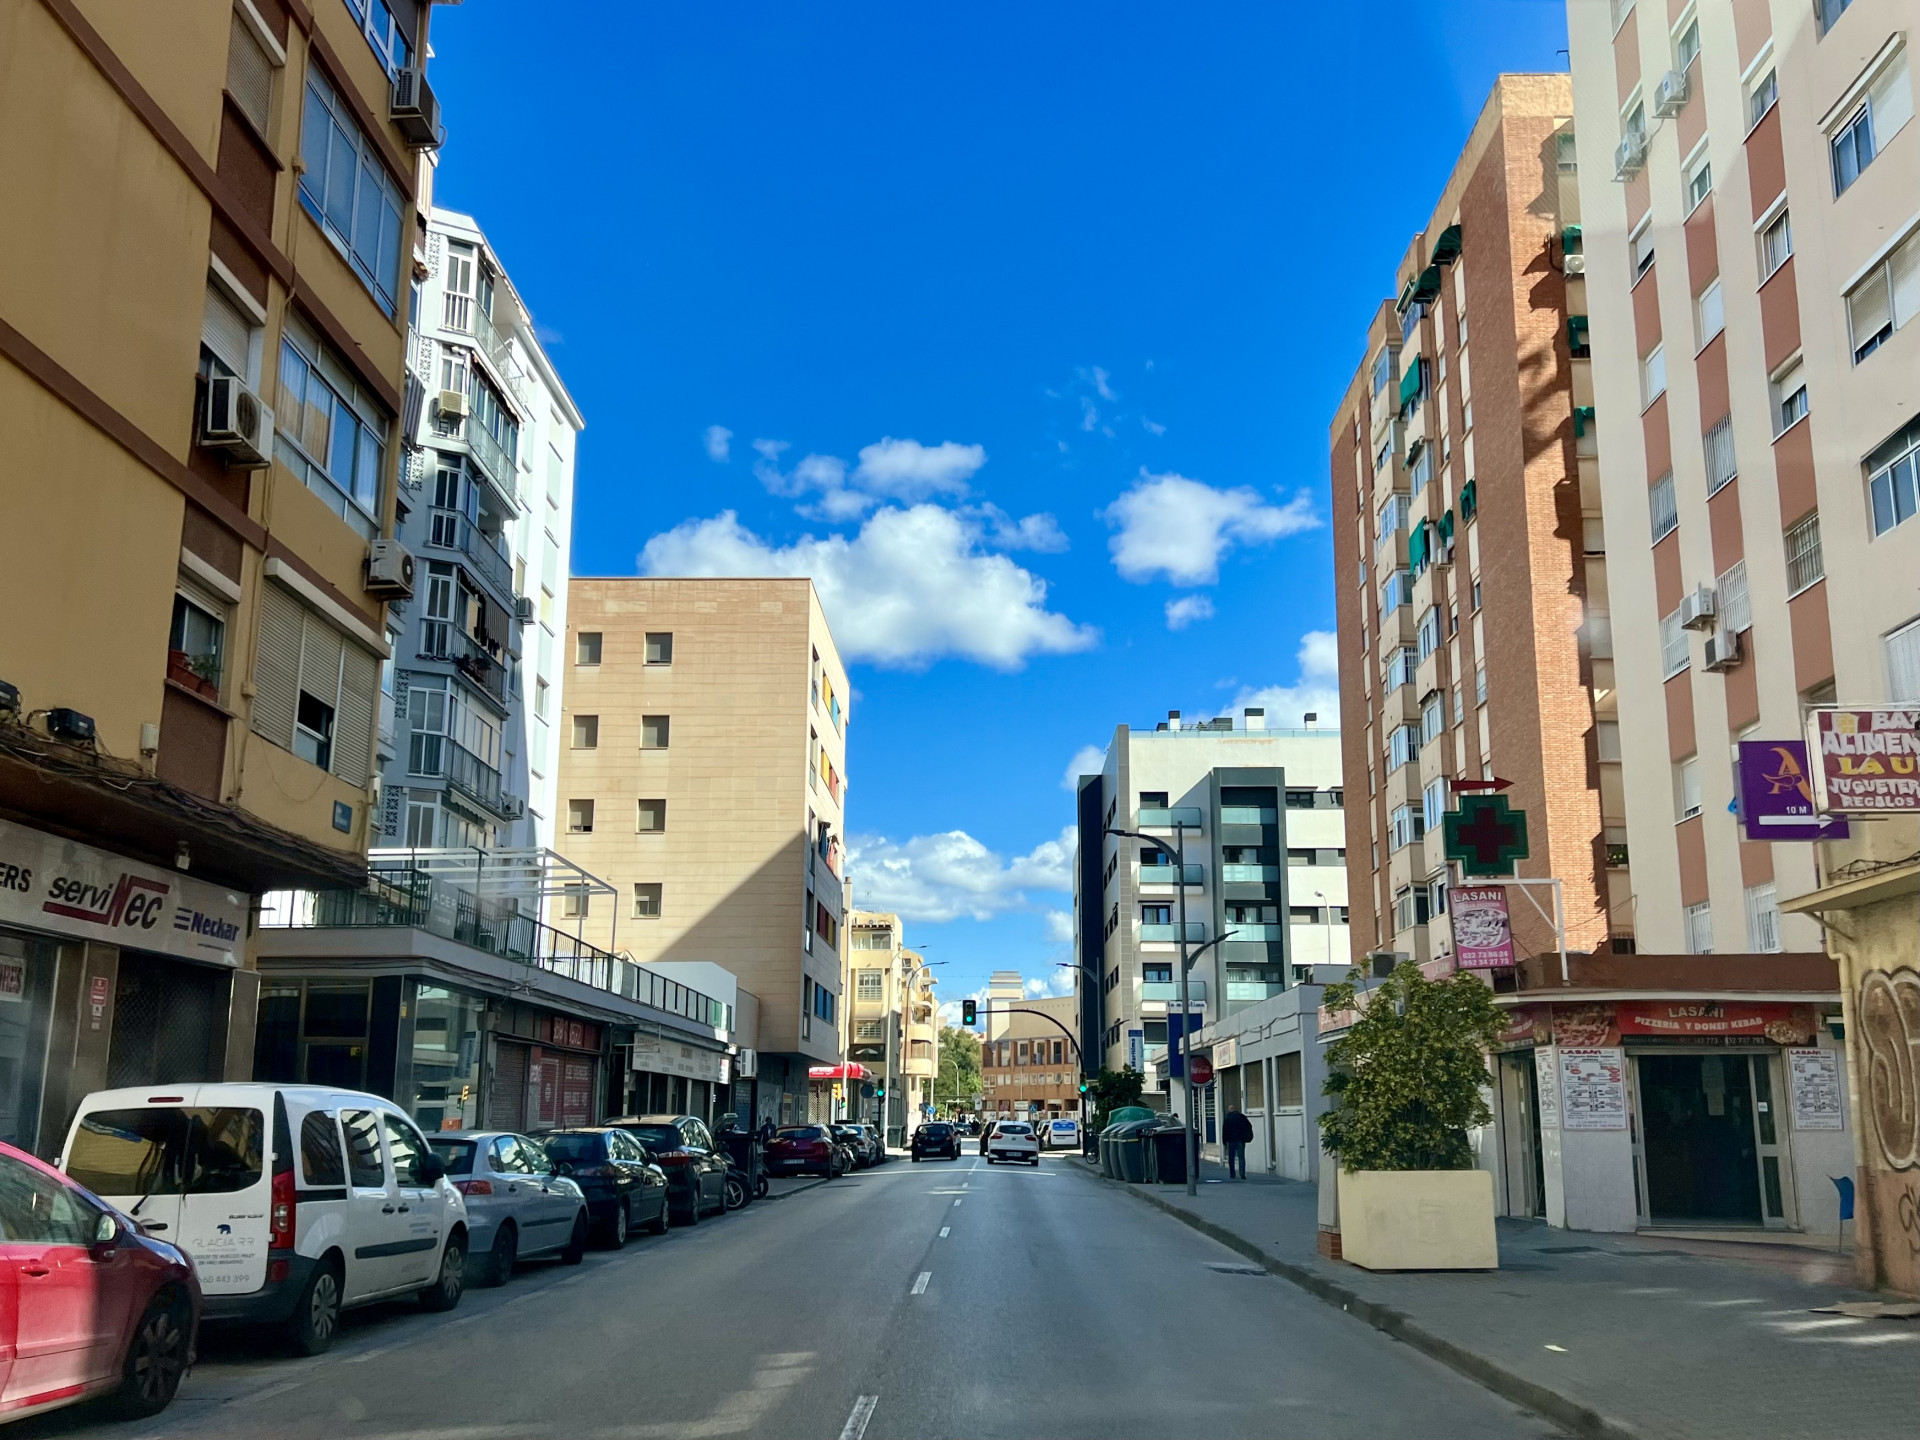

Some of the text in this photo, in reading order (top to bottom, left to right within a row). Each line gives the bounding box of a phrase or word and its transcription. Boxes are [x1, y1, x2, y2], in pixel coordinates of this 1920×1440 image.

[1838, 756, 1920, 775] LA U
[1841, 795, 1915, 808] REGALOS
[1786, 805, 1807, 815] 10 M
[1453, 890, 1502, 904] LASANI
[1634, 1016, 1681, 1030] PIZZERIA
[1685, 1022, 1693, 1031] Y
[1730, 1016, 1764, 1029] KEBAB
